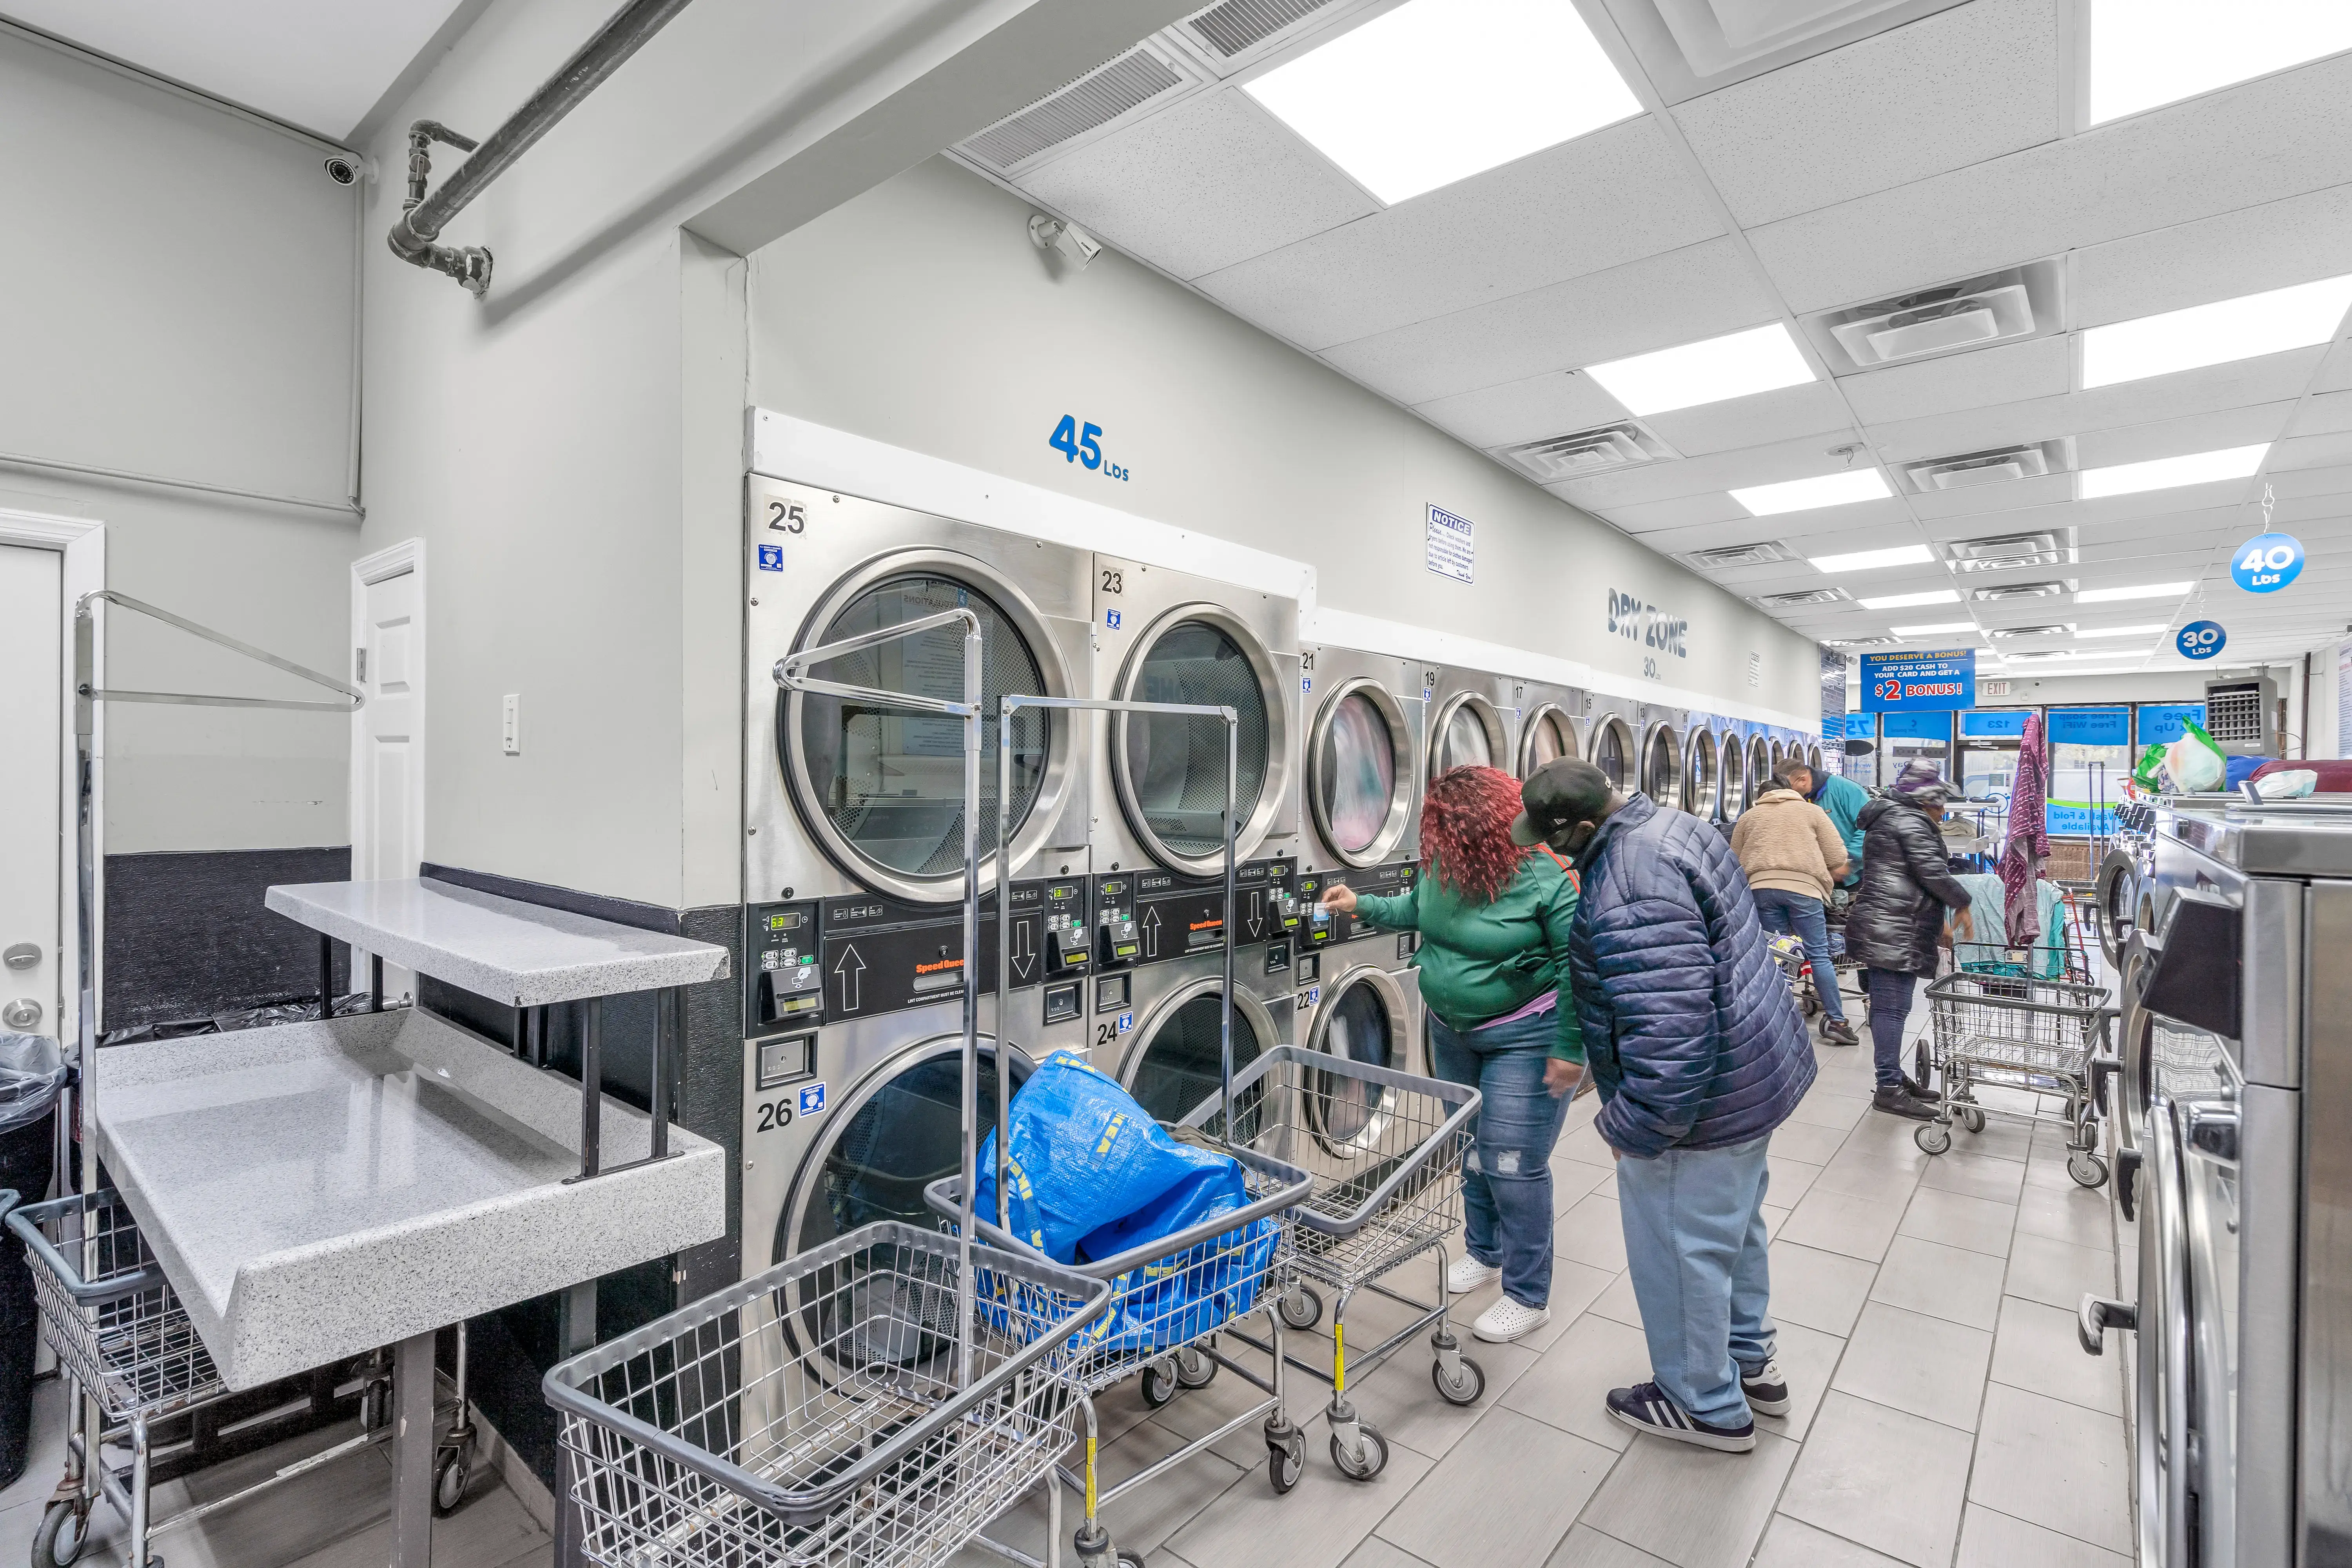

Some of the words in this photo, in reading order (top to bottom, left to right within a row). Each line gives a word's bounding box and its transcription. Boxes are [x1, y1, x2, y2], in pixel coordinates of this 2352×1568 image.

[1049, 414, 1102, 470] 45
[1104, 459, 1129, 482] Lbs
[769, 502, 804, 534] 25
[1434, 511, 1470, 535] NOTICE
[1438, 537, 1446, 545] before
[1434, 545, 1448, 554] responsible
[1429, 558, 1437, 567] before
[1455, 562, 1468, 570] customers
[2239, 545, 2295, 573] 40
[1101, 570, 1122, 594] 23
[2252, 572, 2280, 586] Lbs
[1608, 587, 1641, 641] DRY
[1646, 604, 1688, 658] ZONE
[2182, 628, 2218, 648] 30
[1935, 650, 1967, 658] BONUS!
[2192, 646, 2212, 655] Lbs
[1302, 652, 1314, 670] 21
[1644, 656, 1655, 678] 30
[1425, 671, 1435, 686] 19
[1515, 686, 1523, 698] 17
[1906, 683, 1962, 697] BONUS!
[1987, 682, 2007, 695] EXIT
[1586, 698, 1592, 709] 15
[1640, 707, 1645, 718] 13
[1190, 921, 1207, 931] Speed
[916, 960, 944, 974] Speed
[944, 959, 964, 968] Quee
[1297, 991, 1310, 1010] 22
[1097, 1021, 1118, 1046] 24
[1055, 1056, 1095, 1073] KEA
[757, 1099, 792, 1133] 26
[1096, 1112, 1126, 1153] IKEA
